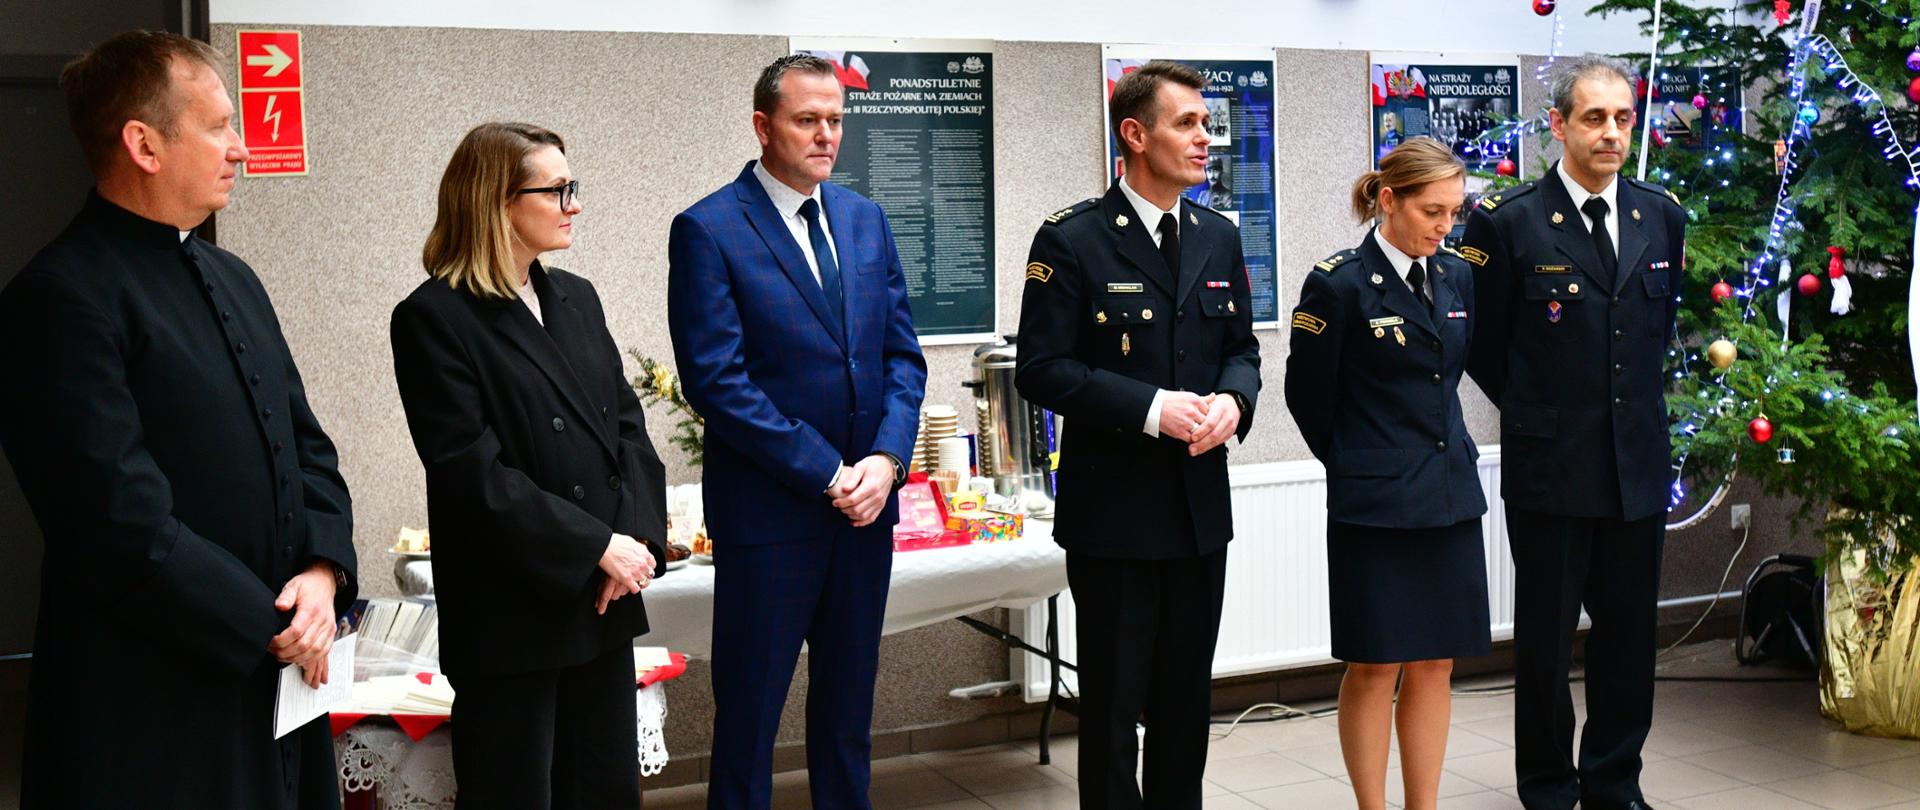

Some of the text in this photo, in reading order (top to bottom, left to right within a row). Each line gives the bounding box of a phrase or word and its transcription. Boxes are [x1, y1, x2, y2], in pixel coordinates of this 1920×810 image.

[1428, 72, 1472, 83] NA STRAŻY
[890, 78, 982, 89] PONADSTULETNIE
[1429, 82, 1512, 96] NIEPODLEGŁOŚCI
[849, 91, 982, 101] STRAŻE POŻARNE NA ZIEMIACH
[862, 105, 942, 116] RZECZYPOSPOLITEJ
